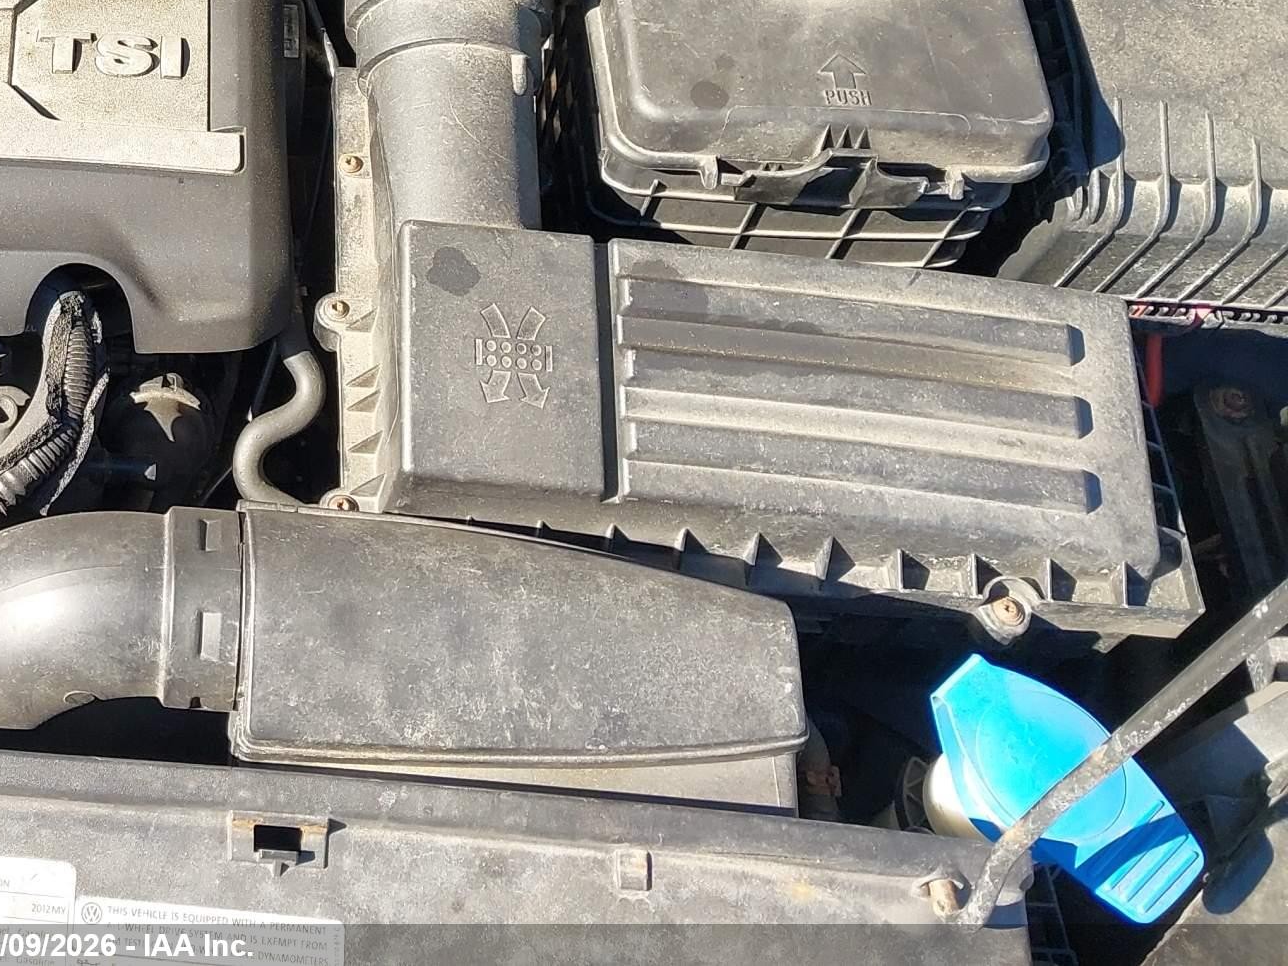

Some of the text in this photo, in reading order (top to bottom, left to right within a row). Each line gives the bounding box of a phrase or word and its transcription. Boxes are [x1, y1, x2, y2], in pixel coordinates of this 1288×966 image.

[37, 28, 186, 80] TSI
[823, 88, 873, 106] PUSH
[106, 905, 128, 917] THIS
[130, 906, 167, 920] VEHICLE
[182, 913, 229, 926] EQUIPPED
[231, 917, 256, 928] WITH
[269, 921, 327, 935] PERMANENT
[106, 921, 154, 934] AL-WHEEL
